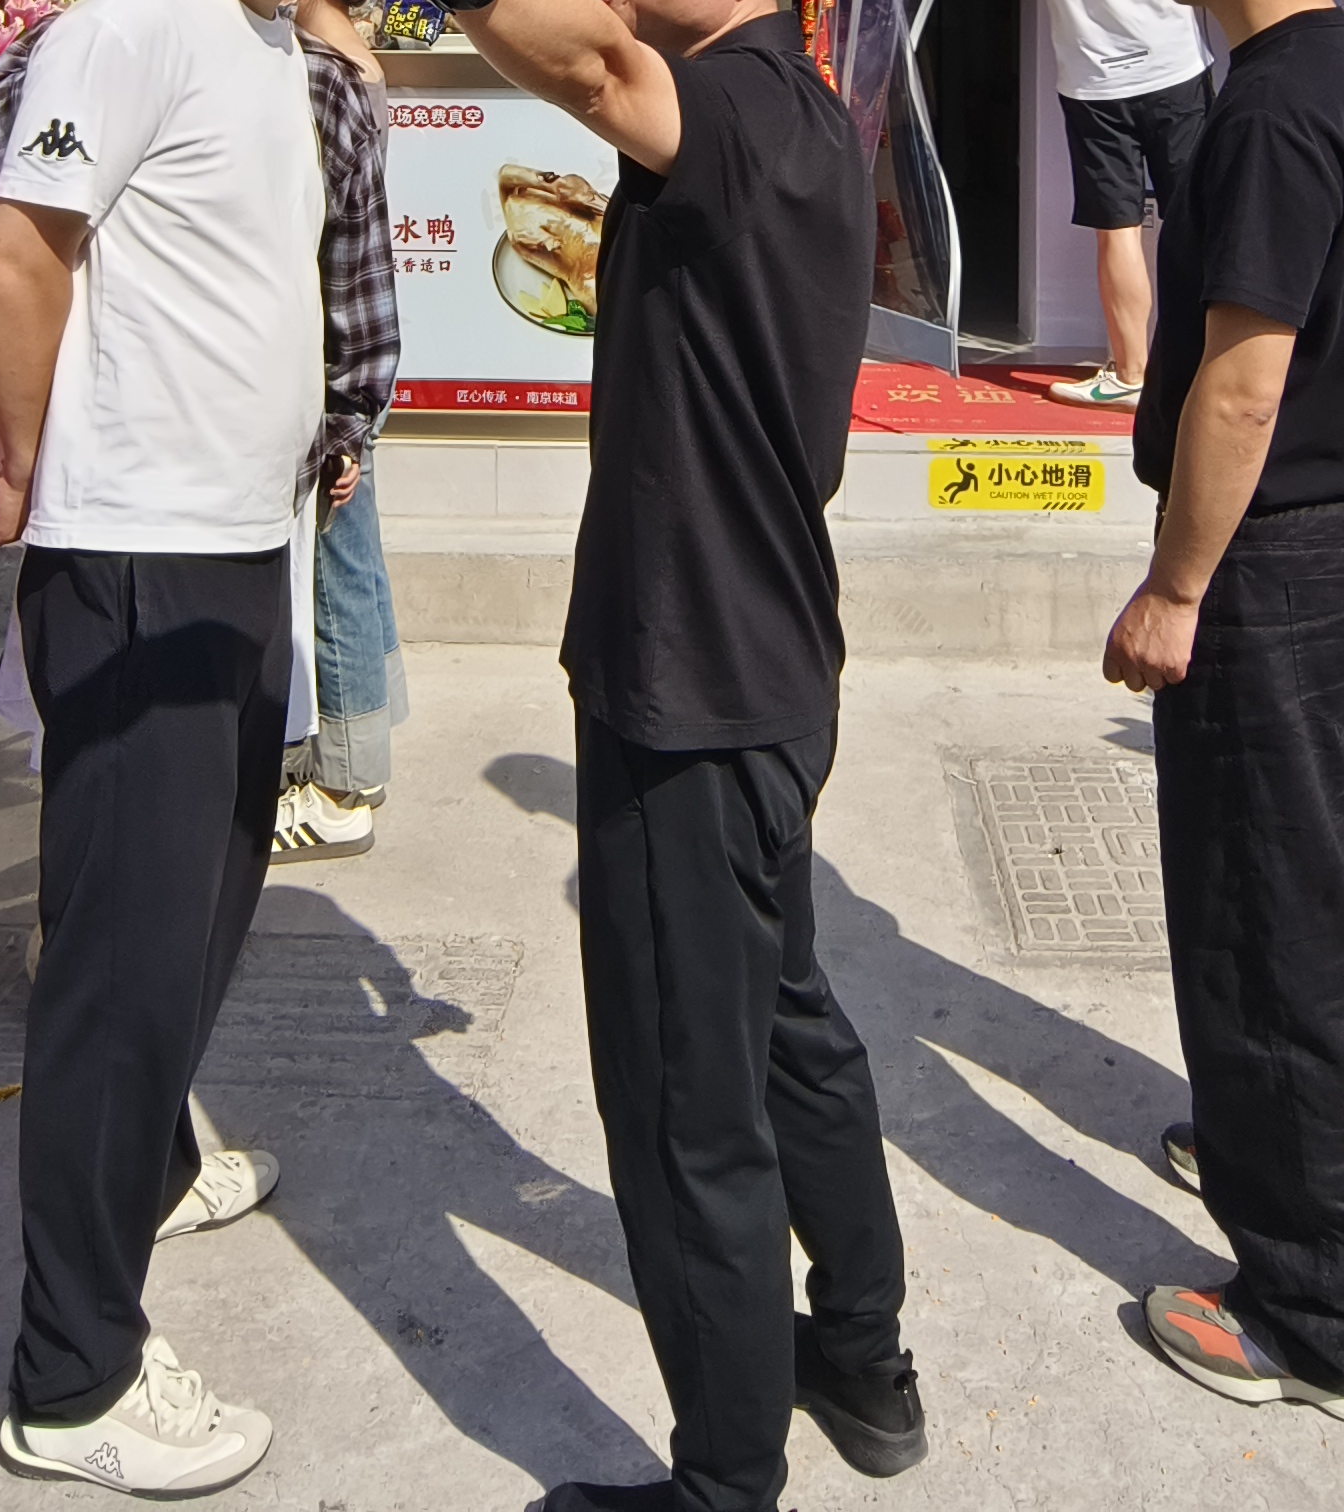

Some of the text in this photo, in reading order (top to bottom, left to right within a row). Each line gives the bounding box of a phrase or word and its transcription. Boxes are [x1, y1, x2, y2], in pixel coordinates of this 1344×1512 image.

[383, 0, 404, 34] COOL
[393, 12, 406, 35] ICE
[402, 4, 421, 37] PACK
[392, 214, 455, 245] 水鸭
[886, 383, 1049, 404] 欢迎
[987, 462, 1092, 489] 小心地滑
[989, 491, 1088, 501] CAUTION WET FLOOR
